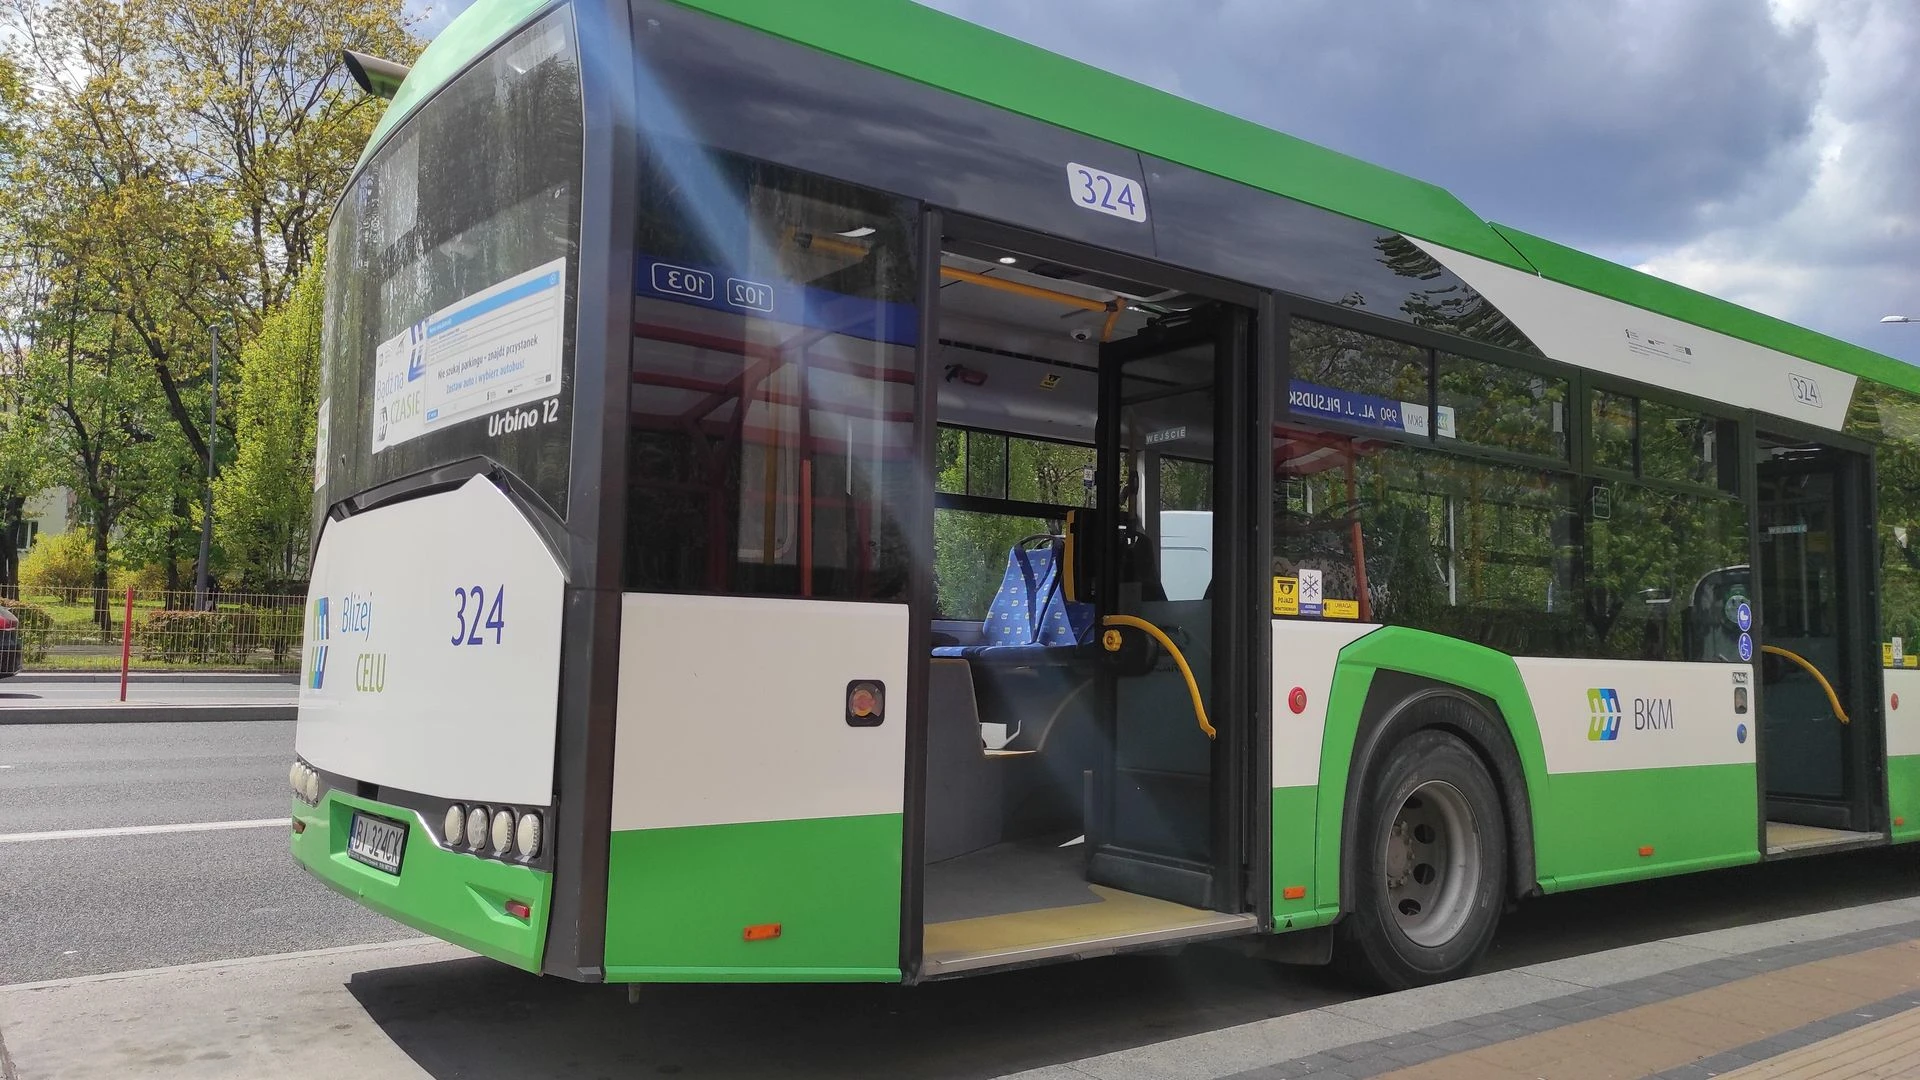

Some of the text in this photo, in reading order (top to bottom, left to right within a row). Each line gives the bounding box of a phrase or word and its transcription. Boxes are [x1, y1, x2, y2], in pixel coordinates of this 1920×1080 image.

[1078, 169, 1135, 215] 324
[446, 362, 460, 376] szukaj
[460, 356, 483, 373] parkingu
[505, 334, 539, 357] przystanek
[377, 372, 404, 402] Bądź na
[478, 369, 499, 385] wybierz
[1792, 377, 1818, 404] 324
[391, 390, 421, 425] CZASIE
[488, 398, 559, 437] Urbino 12
[1145, 427, 1186, 443] WEJŚCIE
[341, 591, 373, 642] Bliżej
[451, 584, 505, 646] 324
[356, 653, 387, 694] CELU
[1634, 698, 1674, 731] BKM
[354, 820, 369, 852] BI
[368, 825, 403, 865] 324CK
